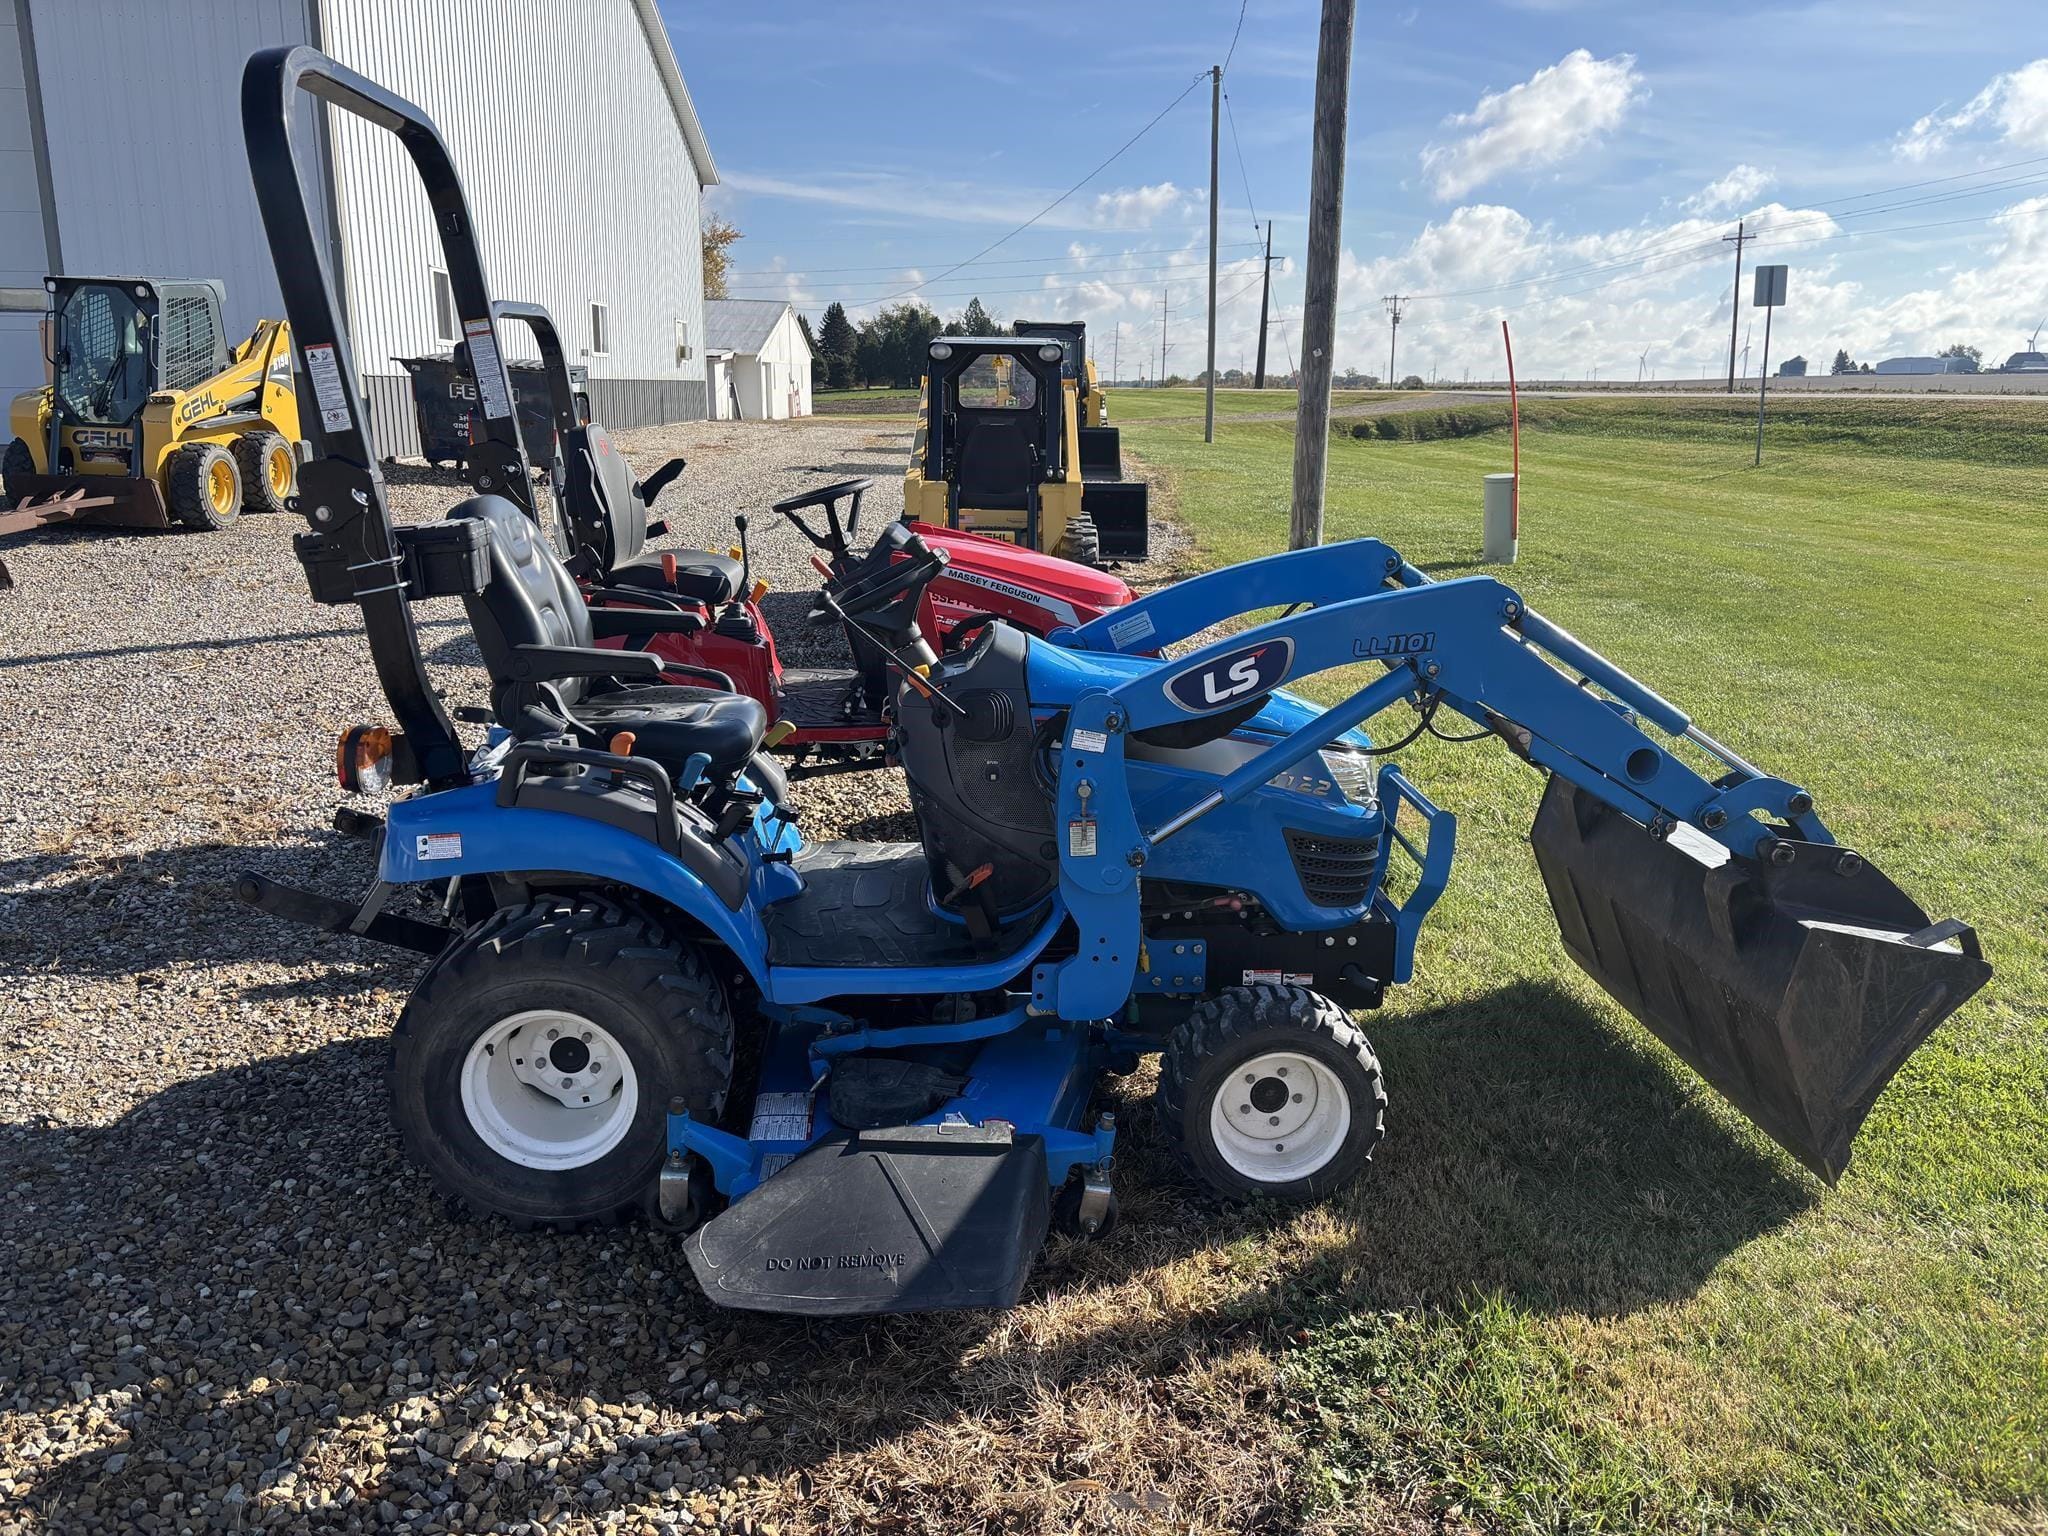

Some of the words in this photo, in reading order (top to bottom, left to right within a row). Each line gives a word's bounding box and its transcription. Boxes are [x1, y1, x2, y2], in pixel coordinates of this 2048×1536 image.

[181, 389, 219, 422] GEHL
[72, 430, 133, 447] GEHL
[948, 569, 989, 586] MASSEY
[990, 581, 1041, 603] FERGUSON
[1353, 632, 1435, 658] LL1101
[1203, 656, 1260, 704] LS
[766, 1257, 793, 1272] DO
[797, 1255, 834, 1271] NOT
[837, 1253, 907, 1269] REMOVE
